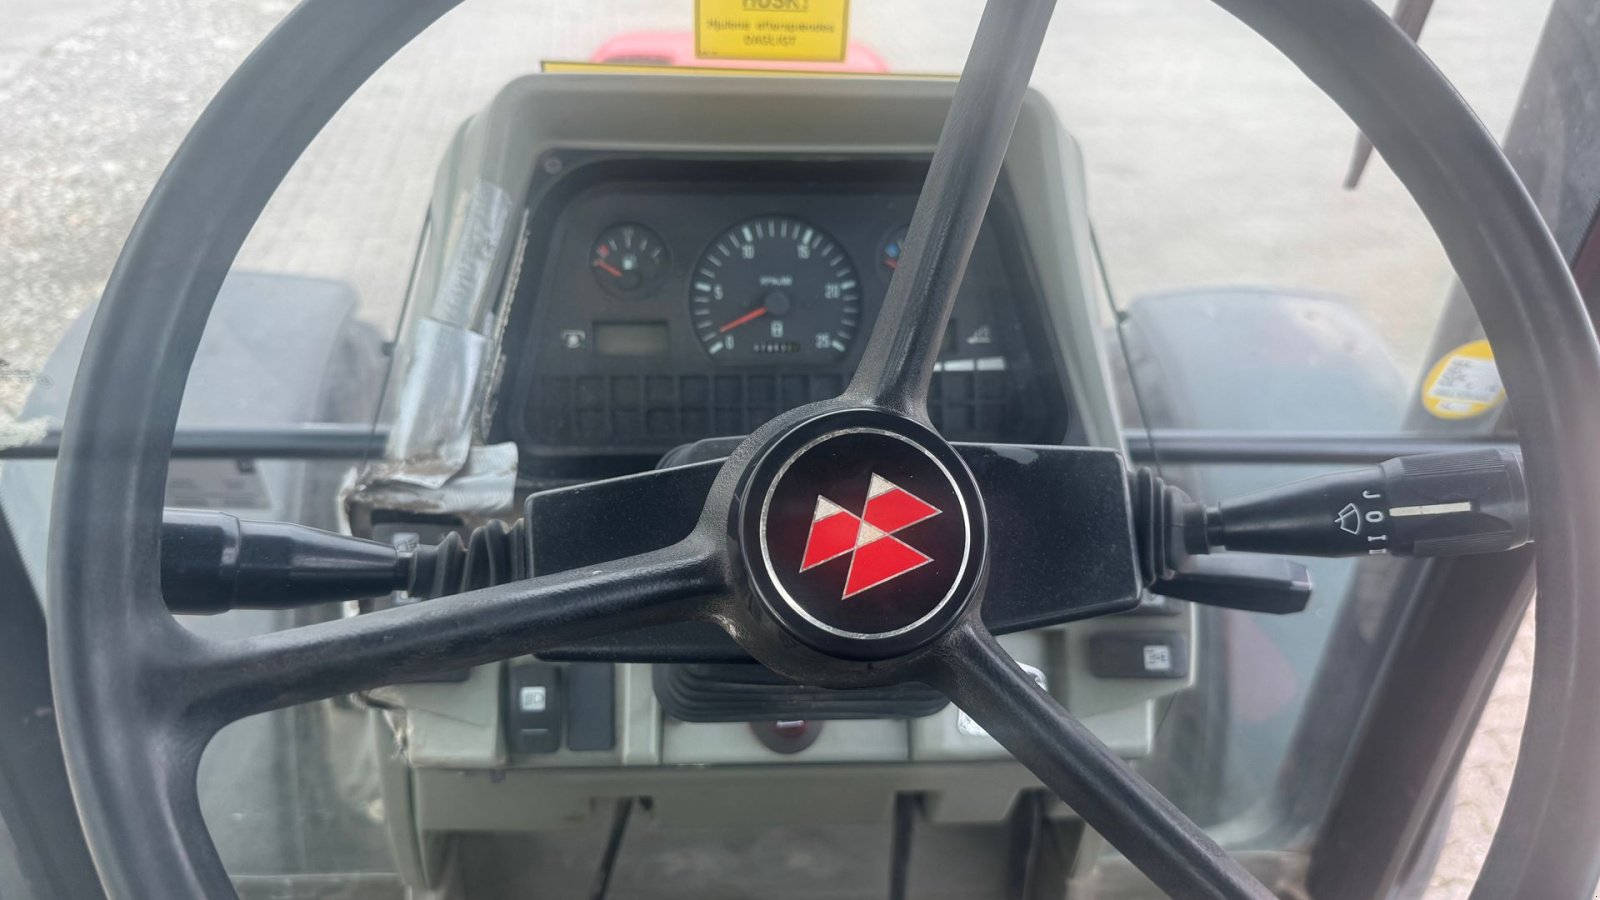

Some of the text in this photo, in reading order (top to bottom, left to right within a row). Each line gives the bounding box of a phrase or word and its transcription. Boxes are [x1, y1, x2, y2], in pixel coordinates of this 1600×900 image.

[742, 244, 754, 259] 10
[798, 244, 810, 259] 15
[714, 284, 723, 300] 5
[825, 283, 840, 299] 20
[725, 334, 734, 349] 0
[816, 333, 831, 348] 25
